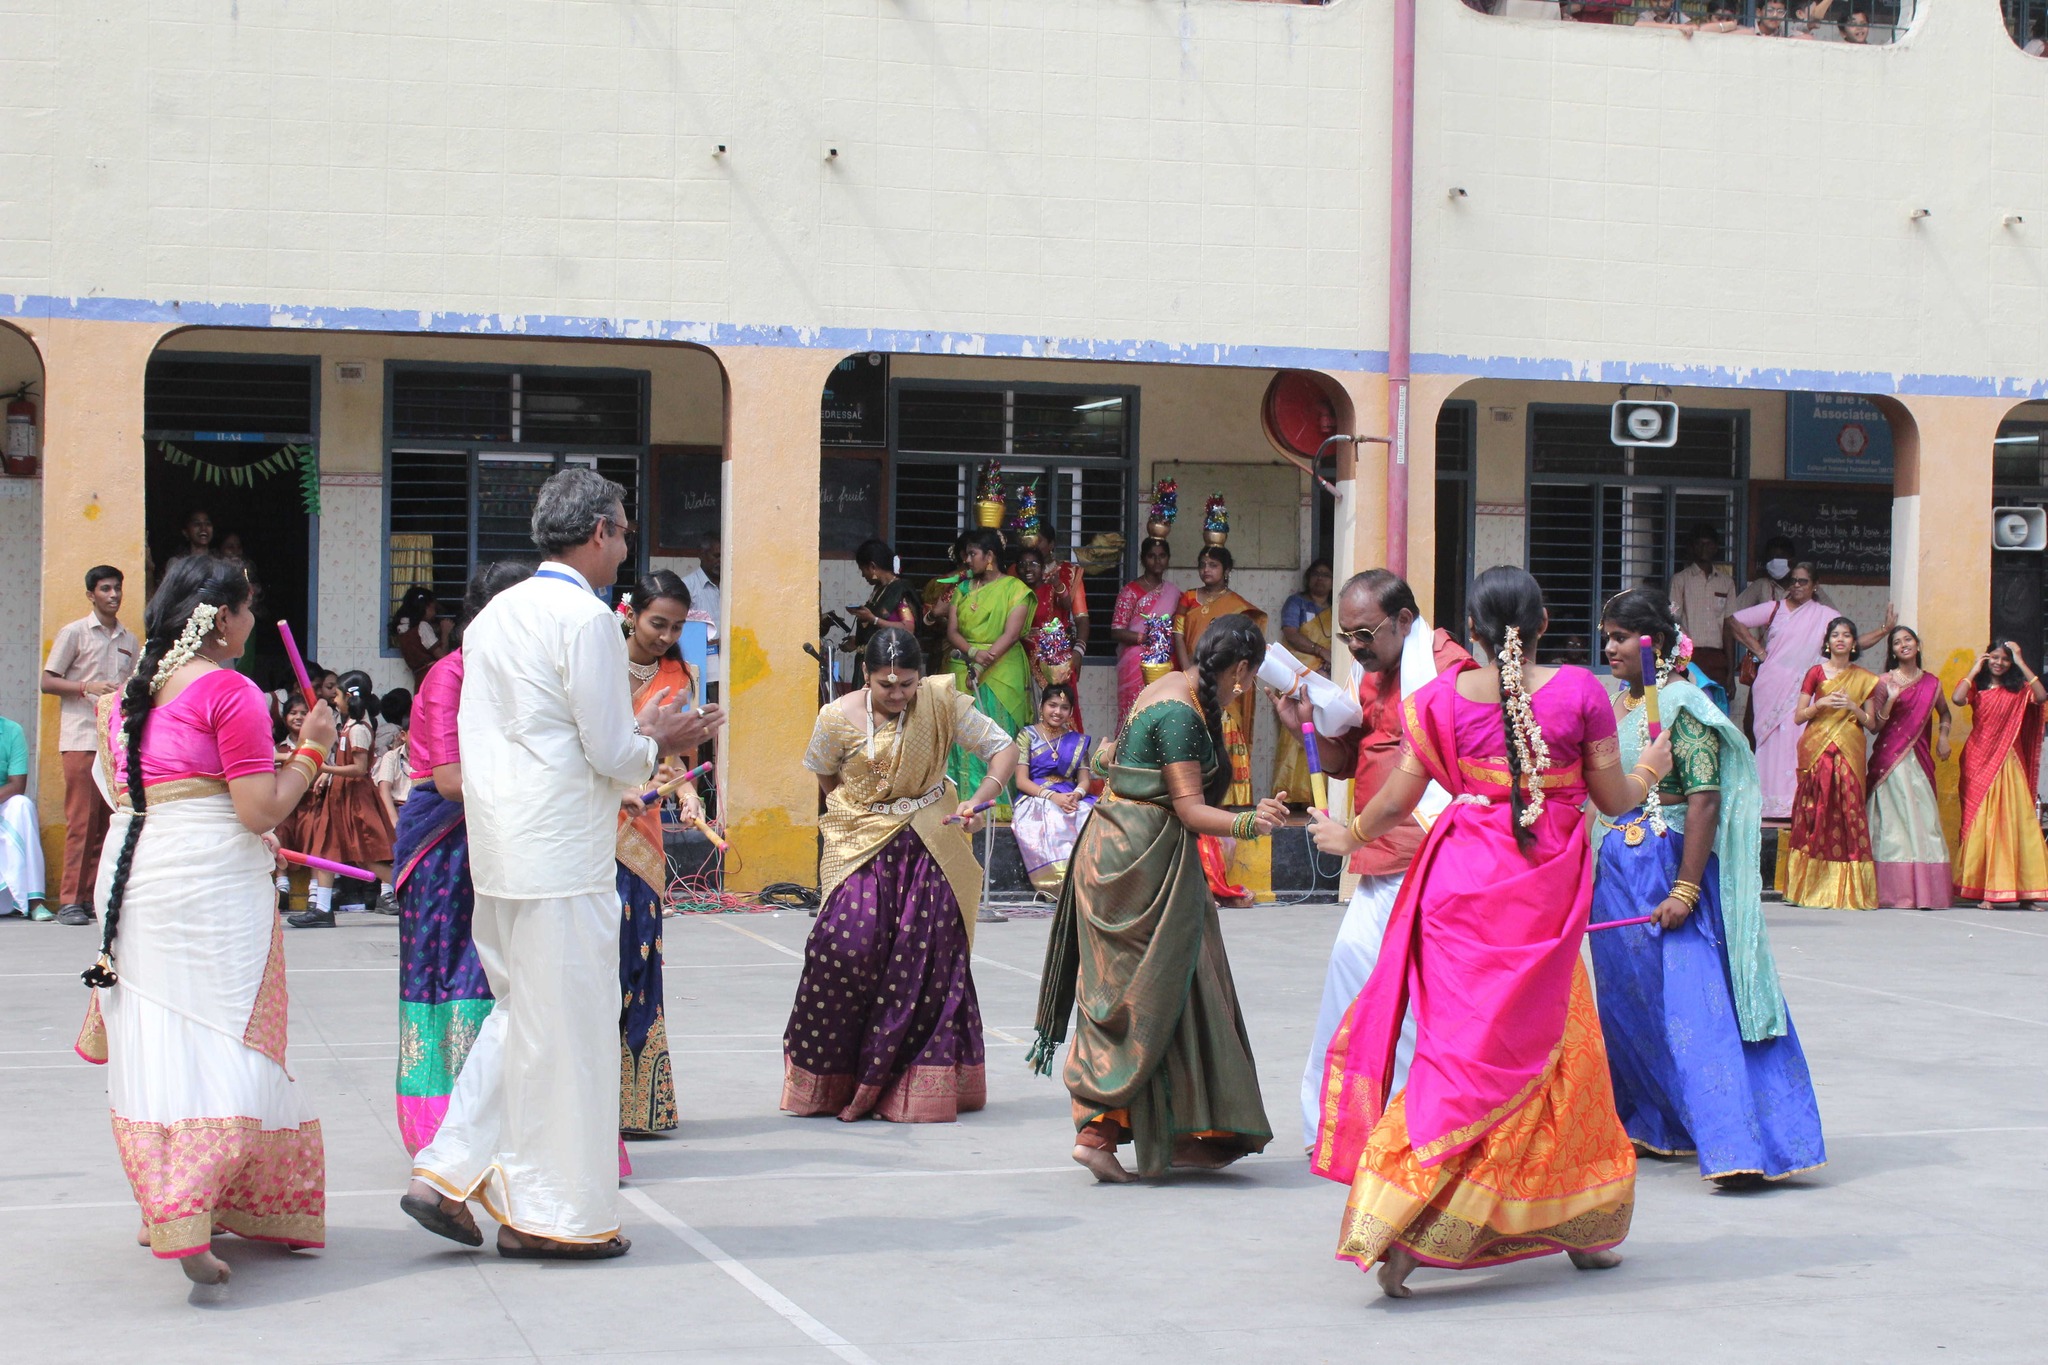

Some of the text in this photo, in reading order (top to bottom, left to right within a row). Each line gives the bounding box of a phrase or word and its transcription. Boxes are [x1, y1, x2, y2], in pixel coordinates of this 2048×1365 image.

[1815, 393, 1832, 404] We
[1835, 395, 1855, 405] are
[821, 410, 863, 420] EDRESSAL
[1813, 407, 1879, 421] Associates
